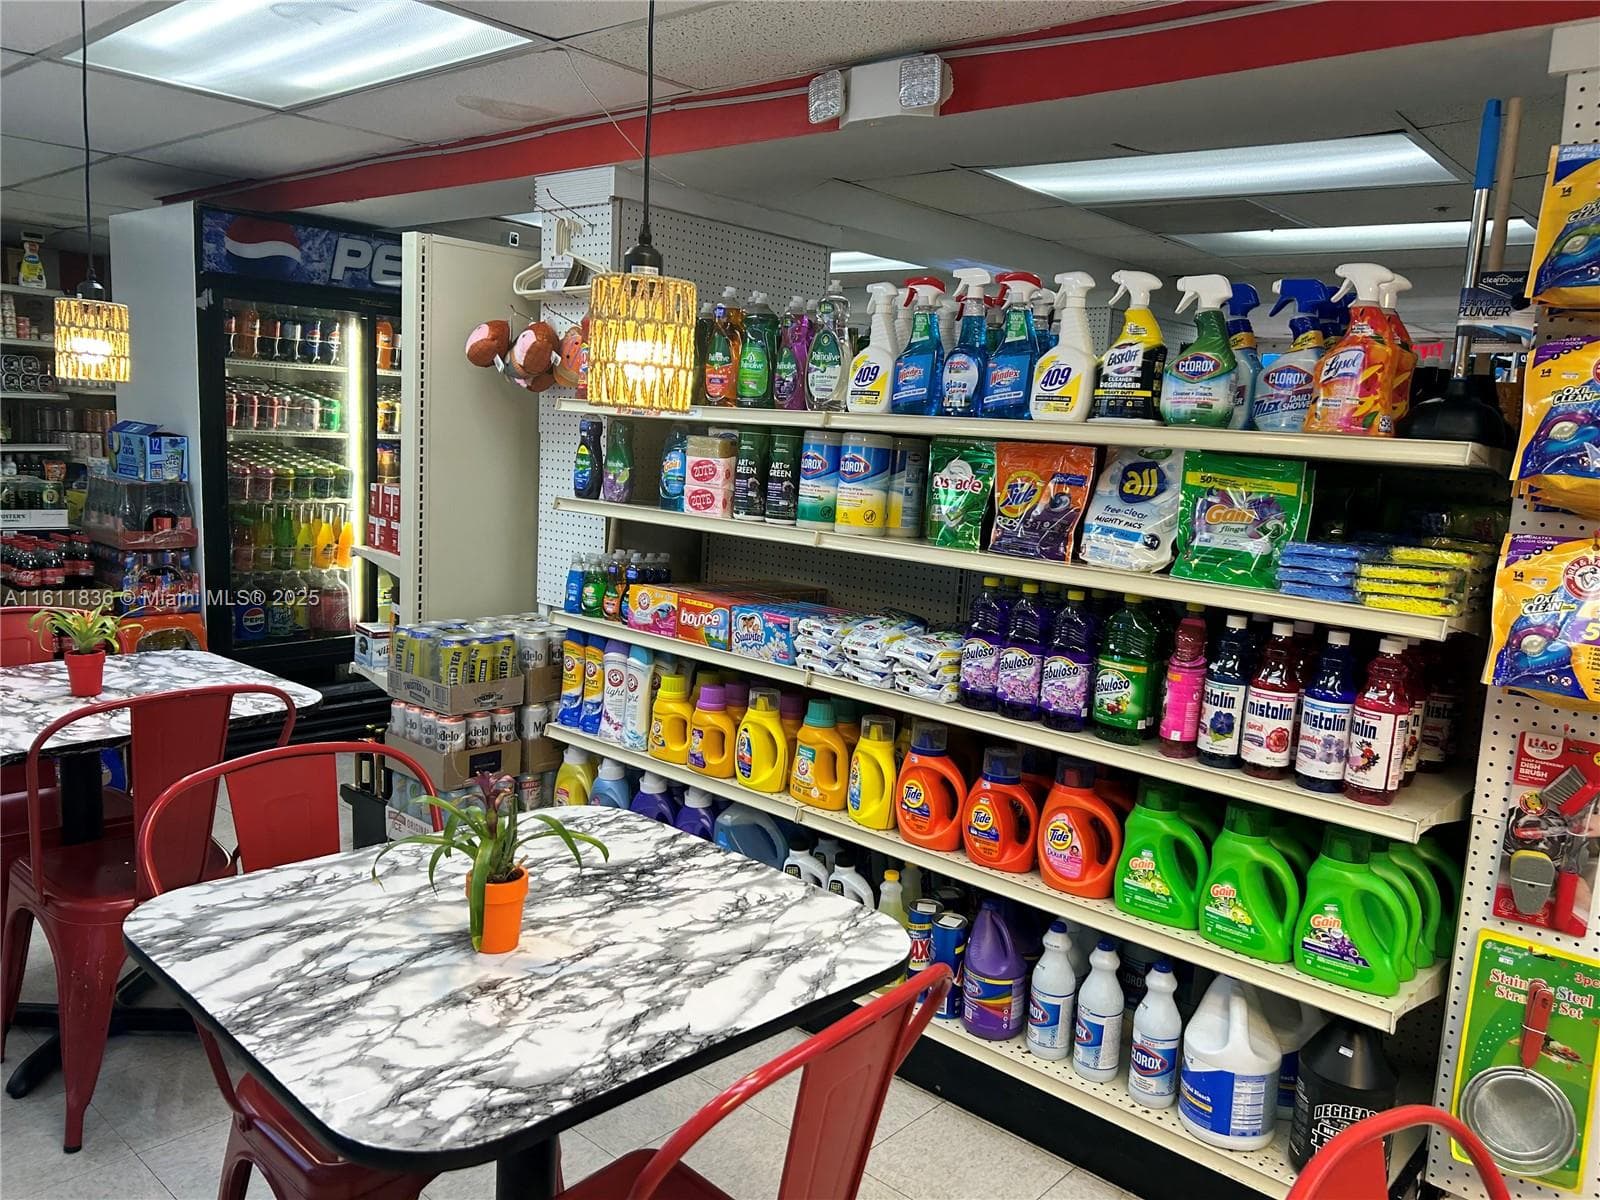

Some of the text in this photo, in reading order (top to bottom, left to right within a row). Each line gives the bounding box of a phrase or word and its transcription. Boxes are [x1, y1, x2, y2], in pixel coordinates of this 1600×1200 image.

[1561, 186, 1572, 194] 14
[1482, 275, 1526, 284] cleanhouse
[1459, 306, 1511, 317] PLUNGER
[811, 350, 842, 361] Palmolive
[1178, 360, 1214, 372] CLOROX
[1324, 350, 1361, 378] Lysol
[855, 365, 880, 384] 409
[898, 367, 923, 382] Windex
[990, 368, 1020, 385] Windex
[1041, 367, 1072, 387] 409
[1268, 372, 1307, 384] CLOROX
[1100, 381, 1141, 389] DEGREASER
[1289, 394, 1312, 402] DAILY
[1553, 394, 1593, 405] CLEAN
[1254, 399, 1281, 416] TILEX
[151, 438, 159, 449] 12
[736, 466, 757, 475] GREEN
[738, 459, 749, 468] ART
[771, 462, 783, 471] ART
[769, 470, 792, 479] GREEN
[1123, 469, 1158, 496] all
[1000, 480, 1038, 507] Tide
[1205, 504, 1257, 525] Gain
[1095, 515, 1123, 525] MIGHTY
[1124, 520, 1143, 530] PACS
[1522, 602, 1562, 615] CLEAN
[680, 608, 719, 626] bounce
[735, 631, 765, 645] Suavitel
[1248, 699, 1293, 721] mistolin
[1303, 709, 1345, 732] mistolin
[1520, 761, 1541, 771] DISH
[1519, 768, 1548, 779] BRUSH
[905, 785, 923, 800] Tide
[973, 810, 992, 825] Tide
[1049, 828, 1070, 842] Tide
[1047, 848, 1071, 864] Downy
[1129, 857, 1155, 871] Gain
[1210, 884, 1236, 898] Gain
[1310, 914, 1341, 929] Gain
[1556, 985, 1594, 1008] Steel
[1557, 1002, 1584, 1020] Set
